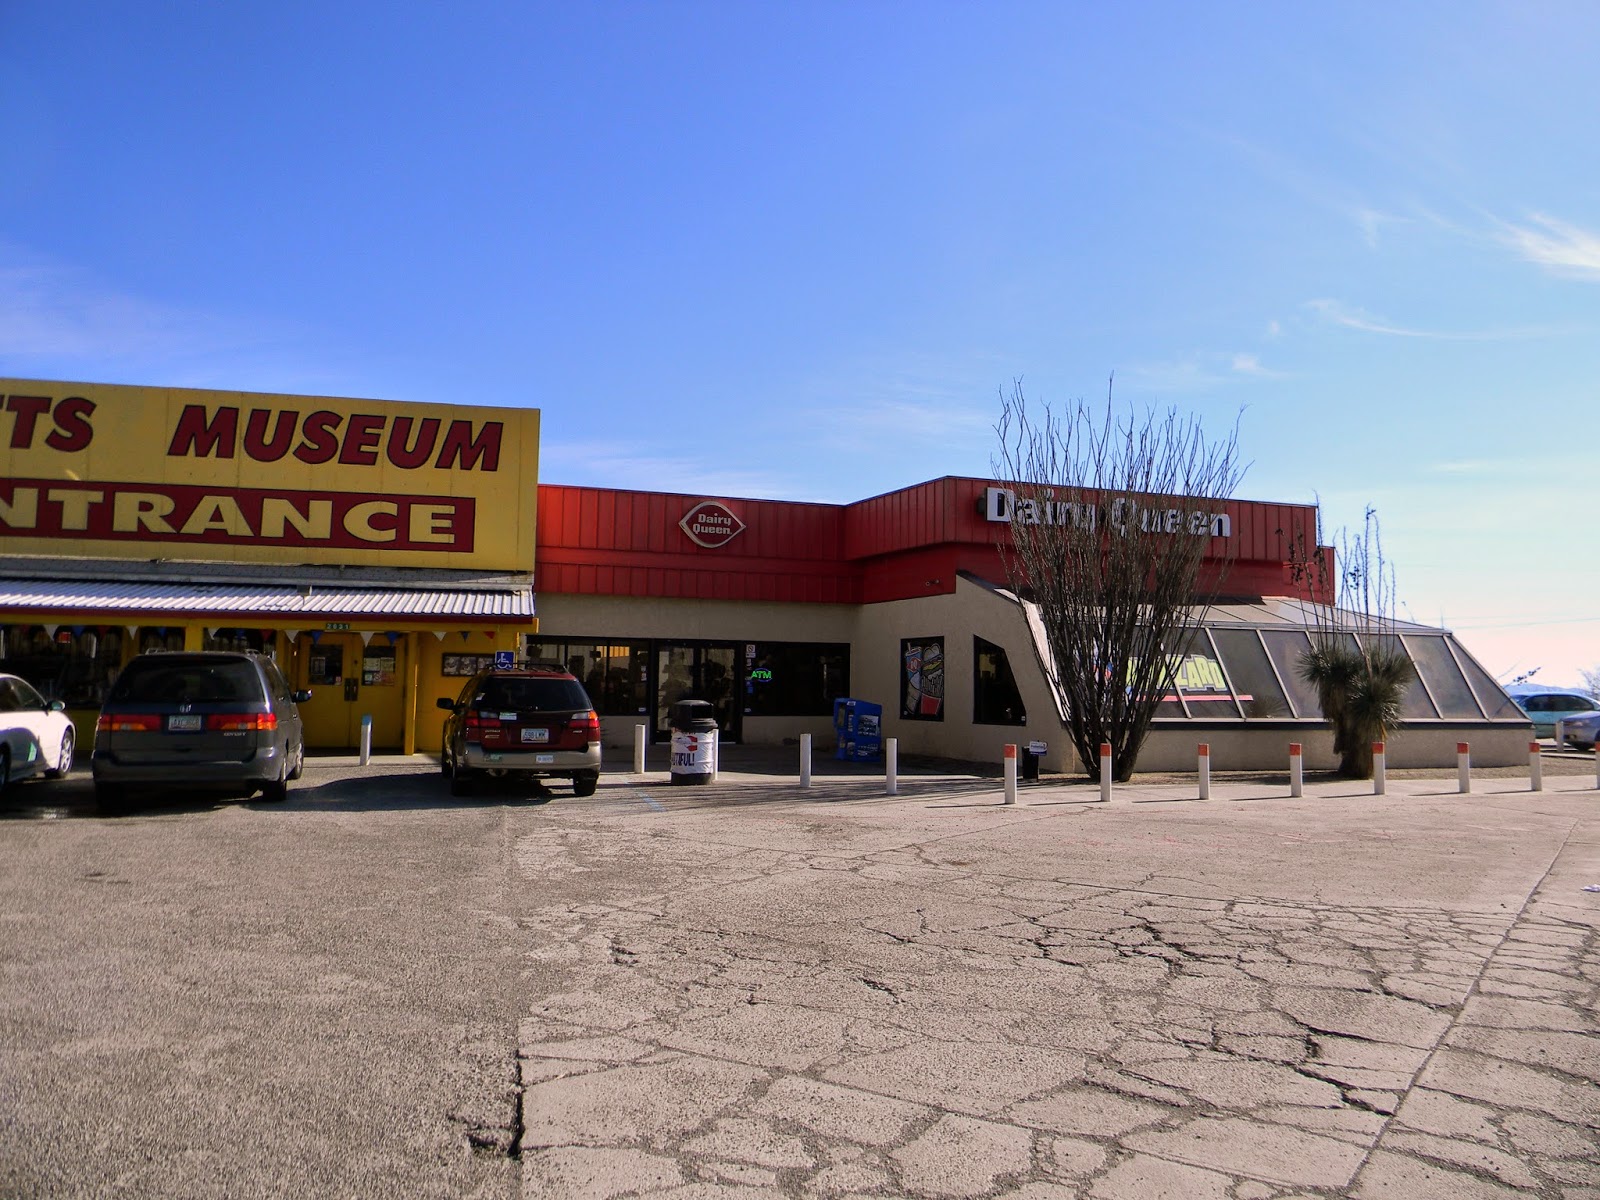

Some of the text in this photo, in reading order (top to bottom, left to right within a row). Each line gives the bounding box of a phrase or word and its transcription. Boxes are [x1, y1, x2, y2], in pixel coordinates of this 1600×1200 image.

[0, 395, 504, 472] TS MUSEUM
[698, 513, 732, 526] Dairy
[692, 523, 731, 535] Queen
[751, 670, 772, 679] ATM
